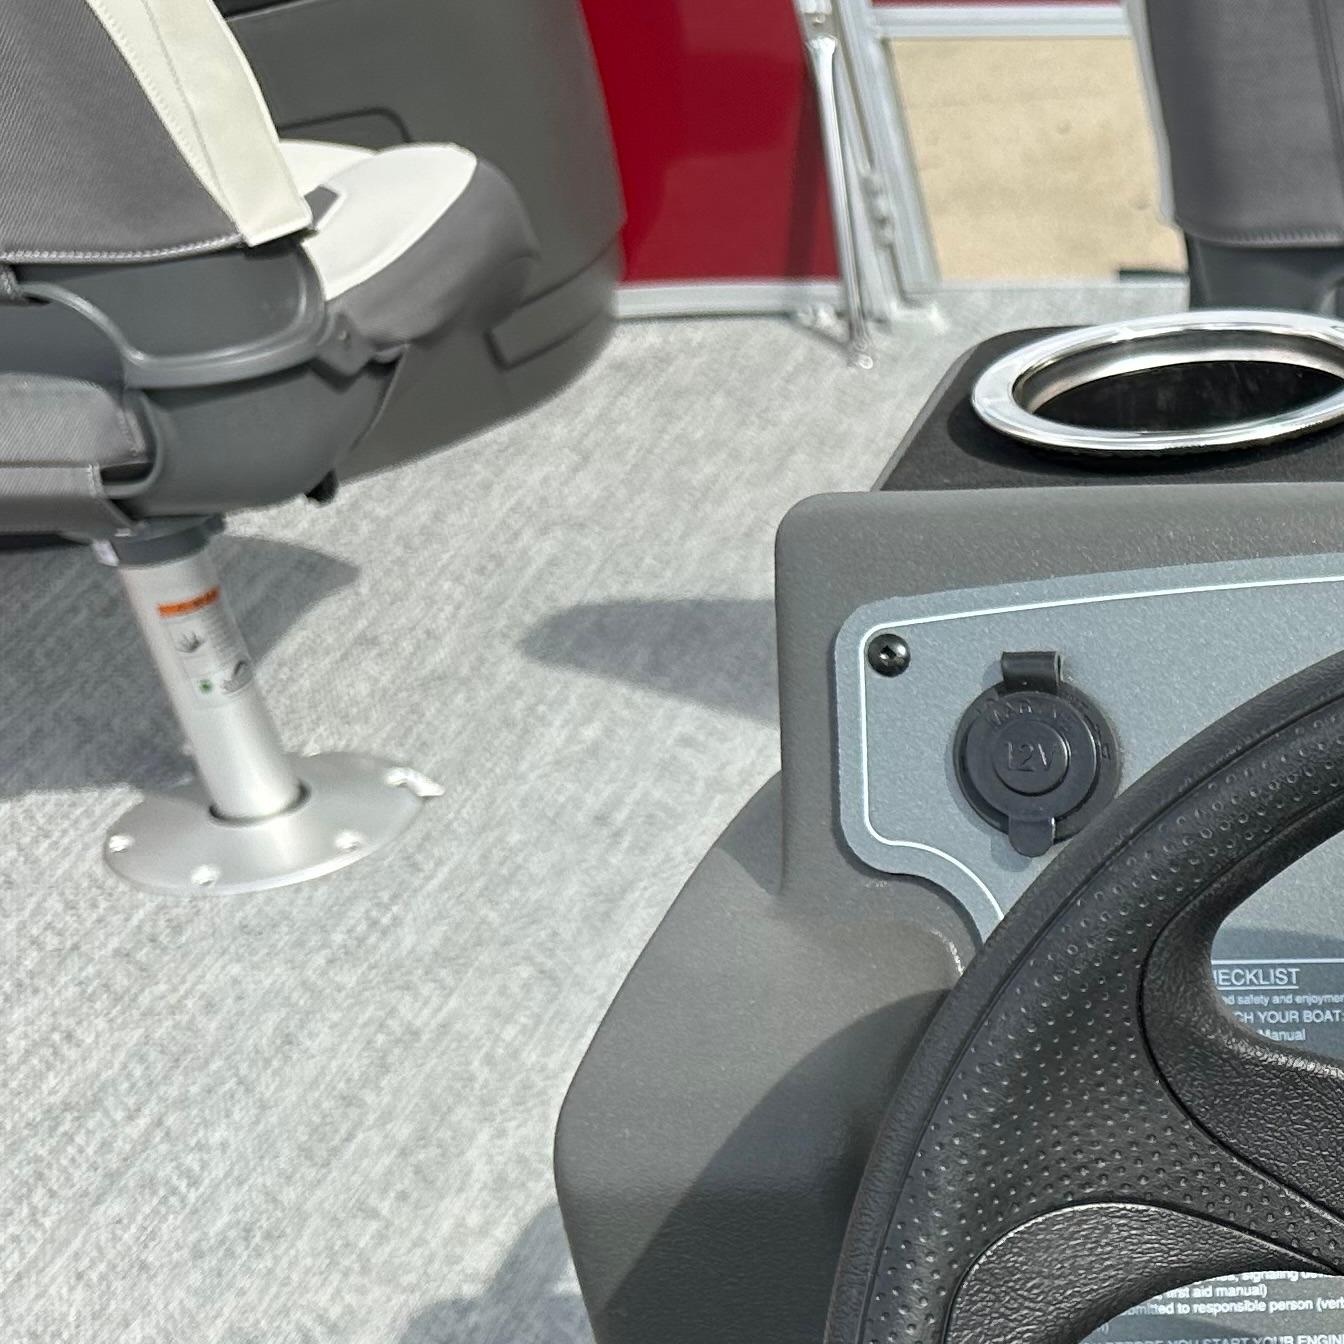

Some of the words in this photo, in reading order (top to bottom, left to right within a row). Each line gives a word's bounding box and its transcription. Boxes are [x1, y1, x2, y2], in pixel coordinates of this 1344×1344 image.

[1008, 741, 1055, 773] 12V
[1212, 968, 1300, 986] ECKLIST
[1238, 993, 1269, 1007] safety
[1272, 993, 1293, 1005] and
[1258, 1011, 1299, 1024] YOUR
[1259, 1028, 1306, 1041] Manual
[1192, 1285, 1213, 1298] aid
[1216, 1284, 1268, 1298] manual)
[1122, 1303, 1174, 1315] bmitted
[1177, 1303, 1190, 1314] to
[1193, 1299, 1267, 1317] responsible
[1269, 1299, 1313, 1313] person
